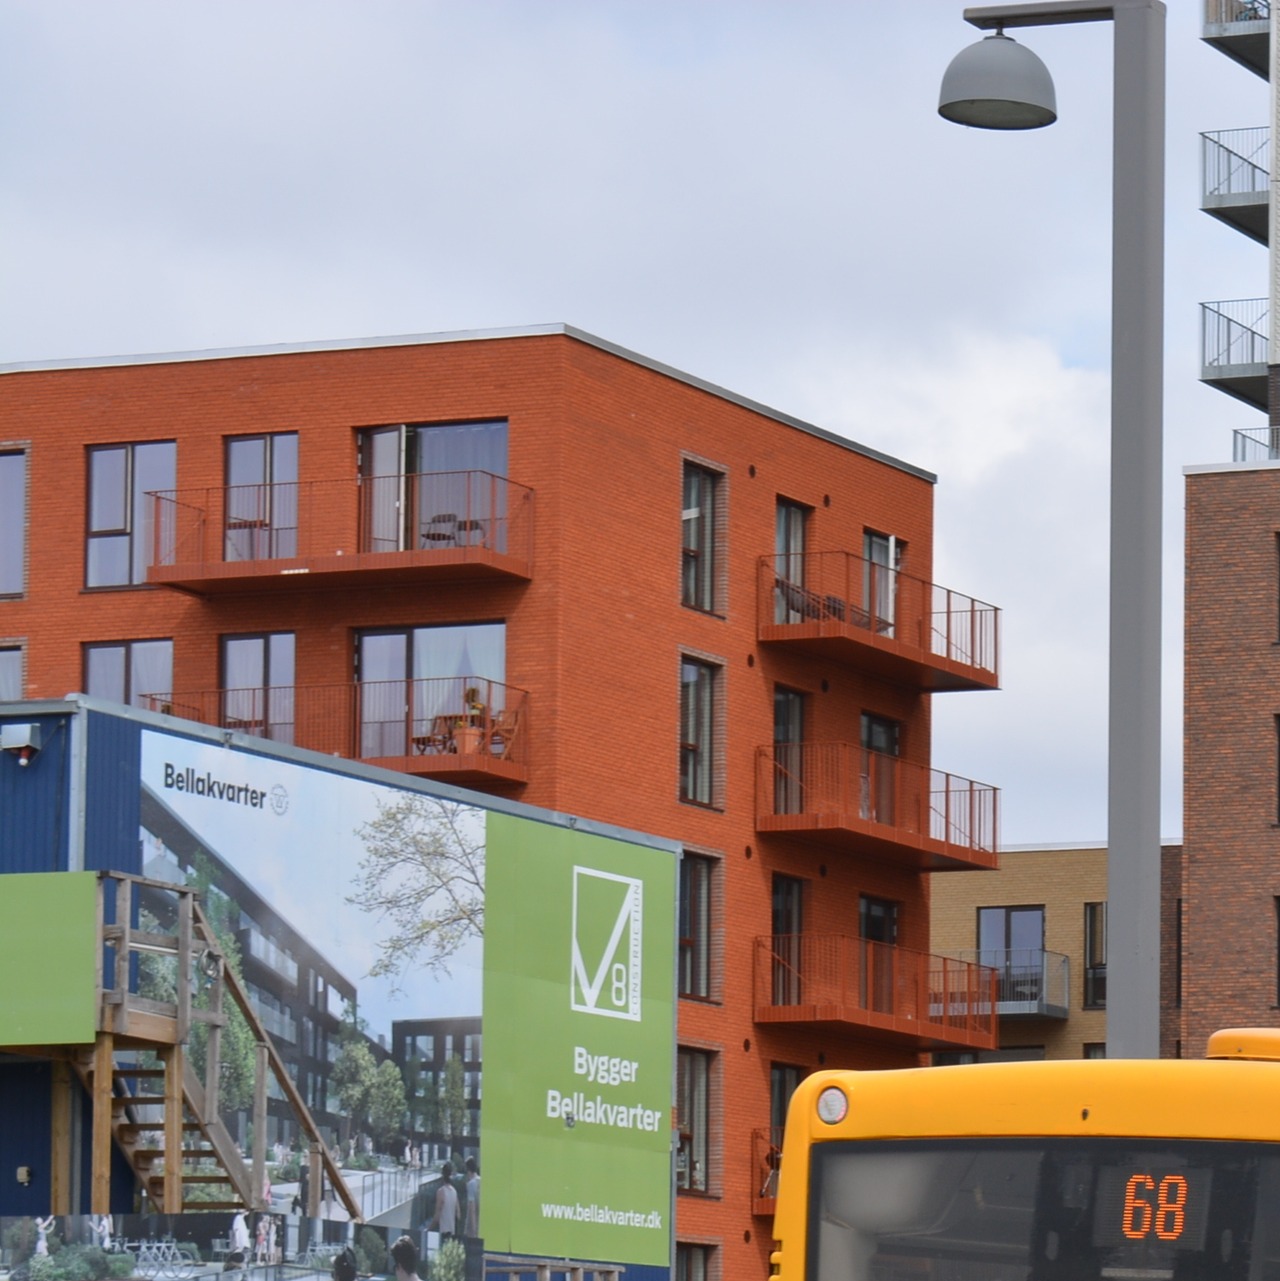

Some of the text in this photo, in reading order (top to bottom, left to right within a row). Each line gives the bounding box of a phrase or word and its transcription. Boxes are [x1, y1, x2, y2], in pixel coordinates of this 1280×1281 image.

[164, 763, 267, 809] Bellakvarter
[632, 884, 641, 1016] CONSTRUCTION
[574, 1047, 638, 1086] Bygger
[547, 1089, 662, 1132] Bellakvarter
[541, 1203, 662, 1229] www.bellakvarter.dk
[1122, 1174, 1188, 1240] 68
